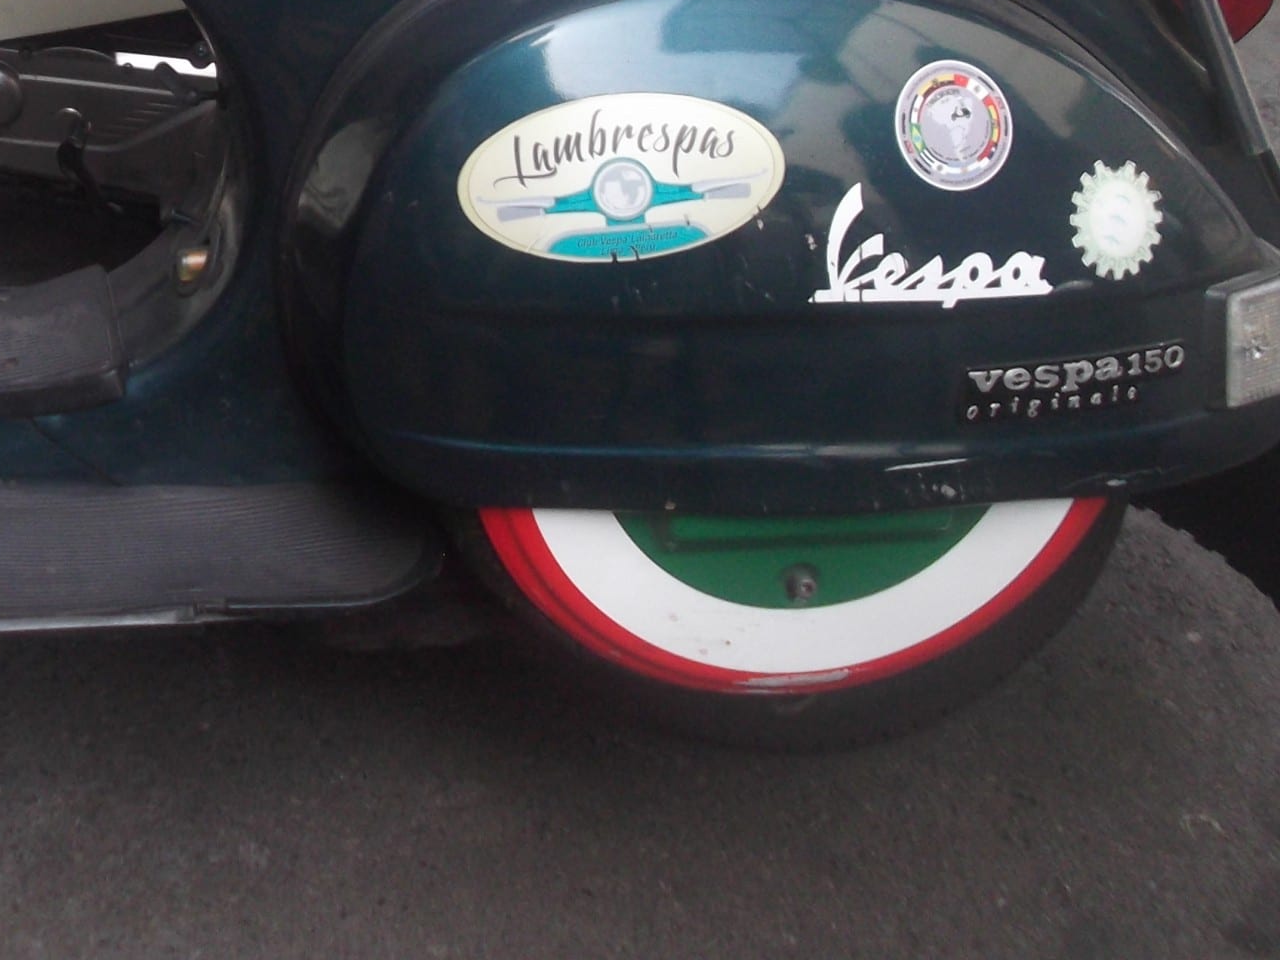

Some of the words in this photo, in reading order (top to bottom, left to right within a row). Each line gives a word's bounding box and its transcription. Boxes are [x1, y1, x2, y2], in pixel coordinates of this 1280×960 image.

[493, 108, 736, 188] Lambrespas
[807, 182, 1055, 309] Vespa
[967, 355, 1123, 393] vespa
[1127, 345, 1186, 377] 150
[965, 384, 1138, 421] originale
